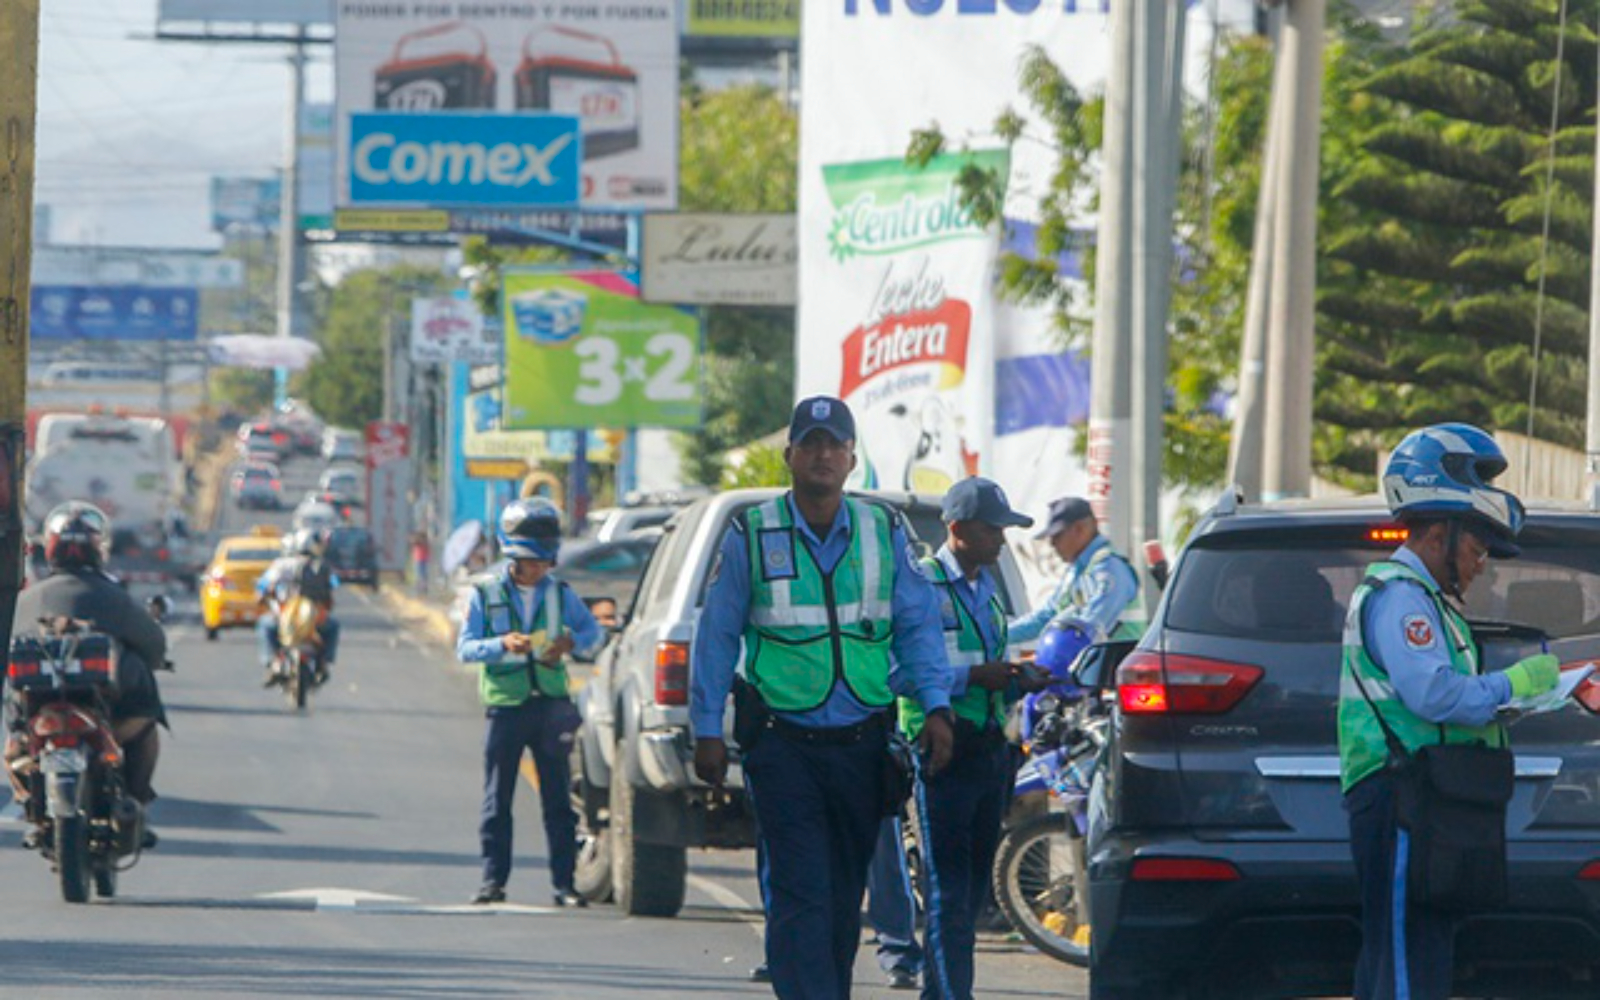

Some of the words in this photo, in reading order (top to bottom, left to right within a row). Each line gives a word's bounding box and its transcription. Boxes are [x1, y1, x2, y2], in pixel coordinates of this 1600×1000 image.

[341, 3, 406, 18] PODER
[413, 3, 452, 18] POR
[458, 4, 535, 19] DENTRO
[541, 5, 551, 19] Y
[561, 5, 598, 20] POR
[605, 6, 670, 21] FUERA
[353, 132, 576, 187] Comex
[860, 323, 948, 376] Entera
